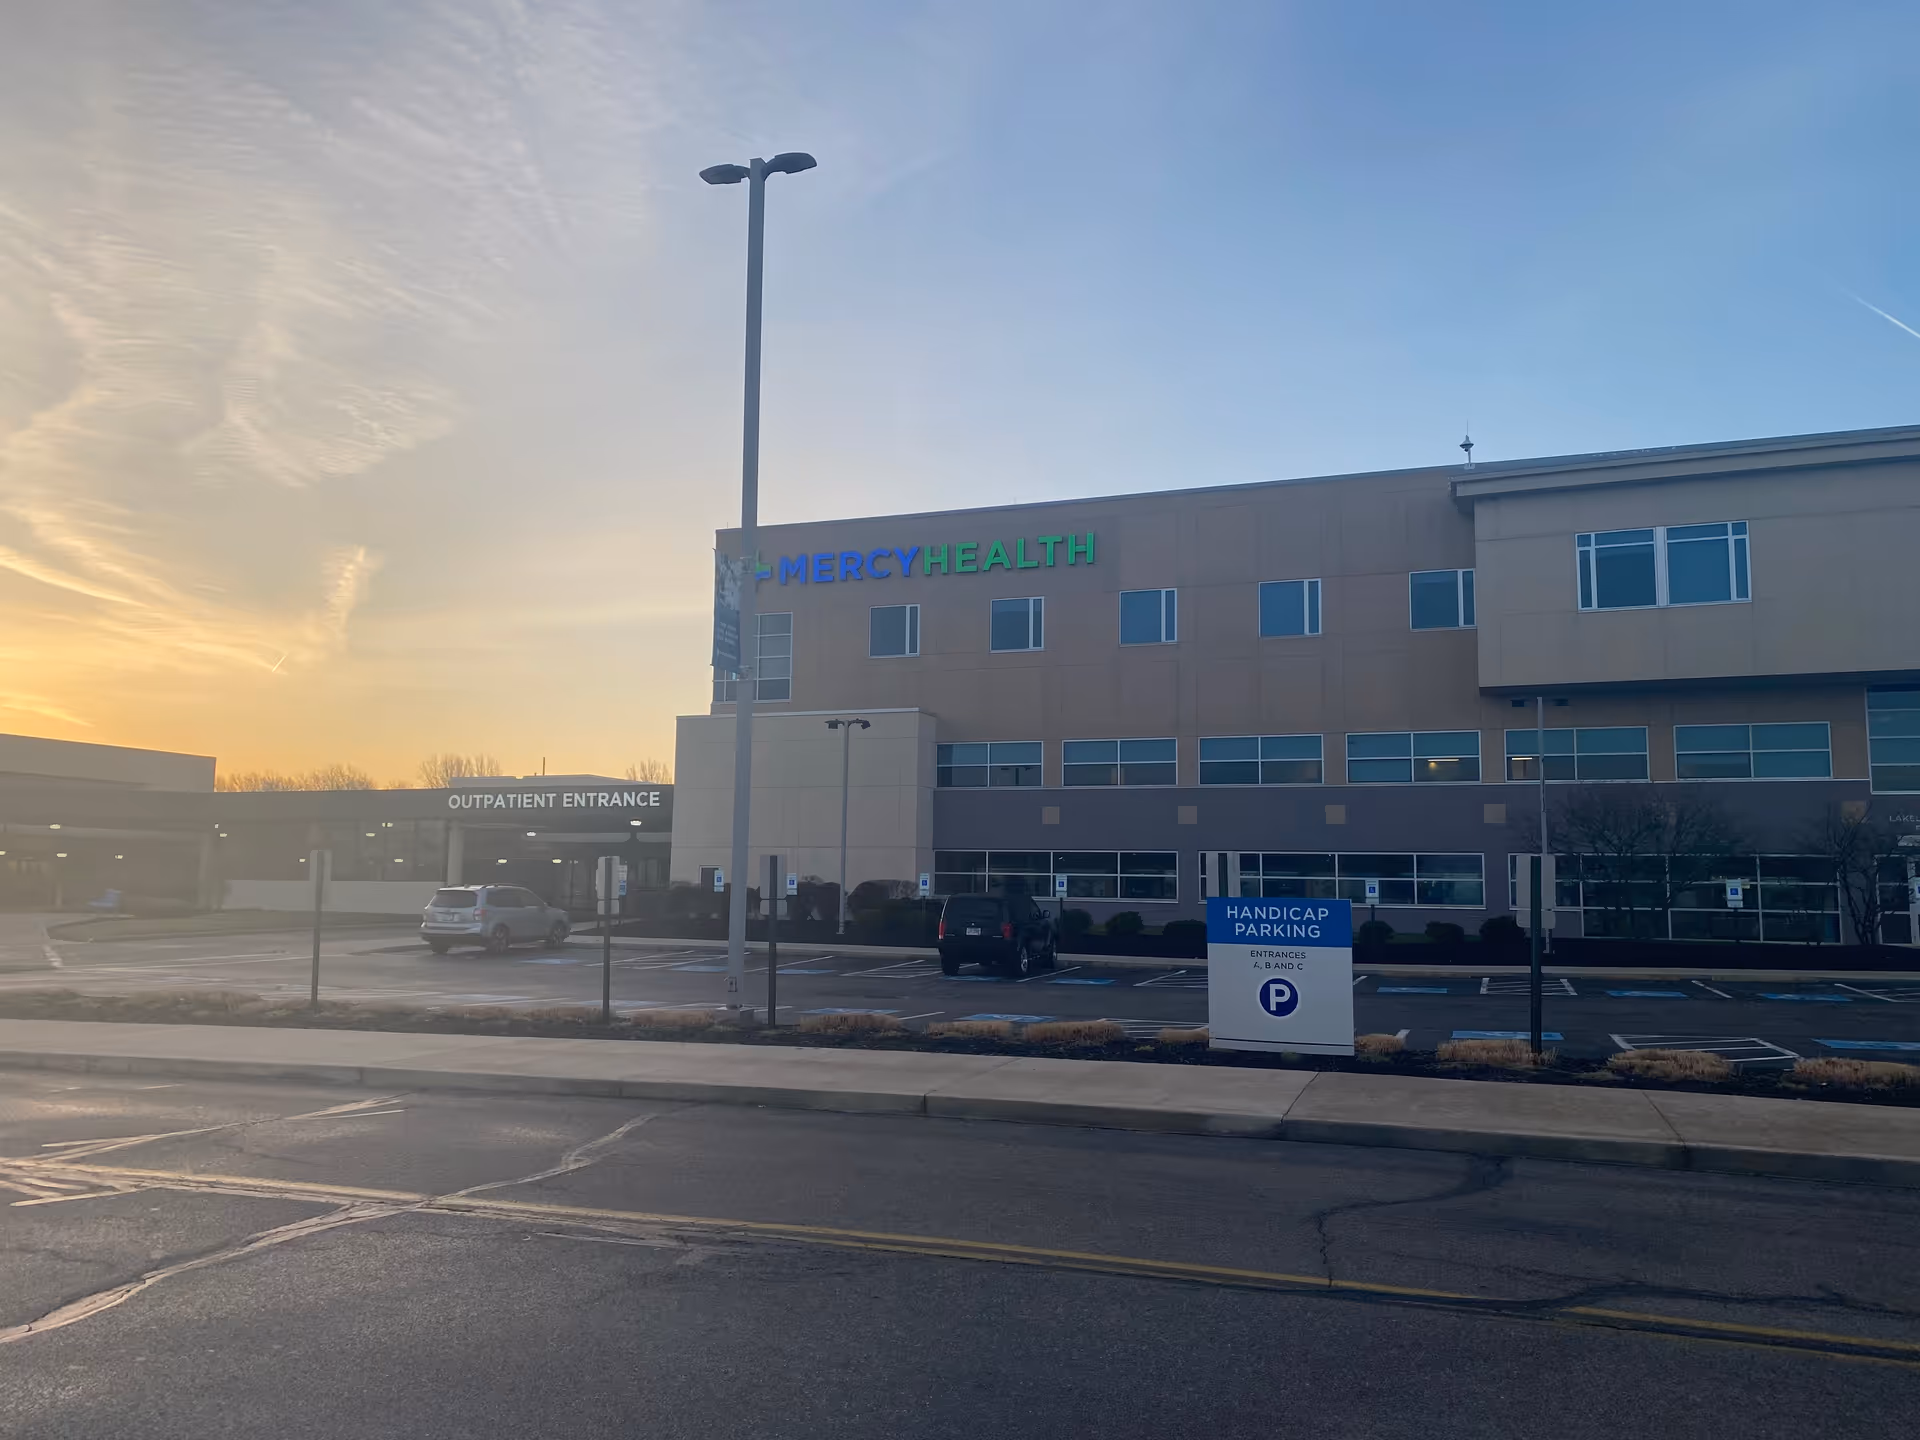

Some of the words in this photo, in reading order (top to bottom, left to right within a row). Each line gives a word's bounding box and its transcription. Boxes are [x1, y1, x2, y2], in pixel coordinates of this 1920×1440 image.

[448, 793, 557, 810] OUTPATIENT
[562, 791, 661, 808] ENTRANCE
[1227, 905, 1329, 921] HANDICAP
[1235, 923, 1321, 938] PARKING
[1250, 950, 1306, 959] ENTRANCES
[1253, 961, 1263, 970] A,
[1273, 962, 1294, 970] AND
[1269, 984, 1291, 1011] P
